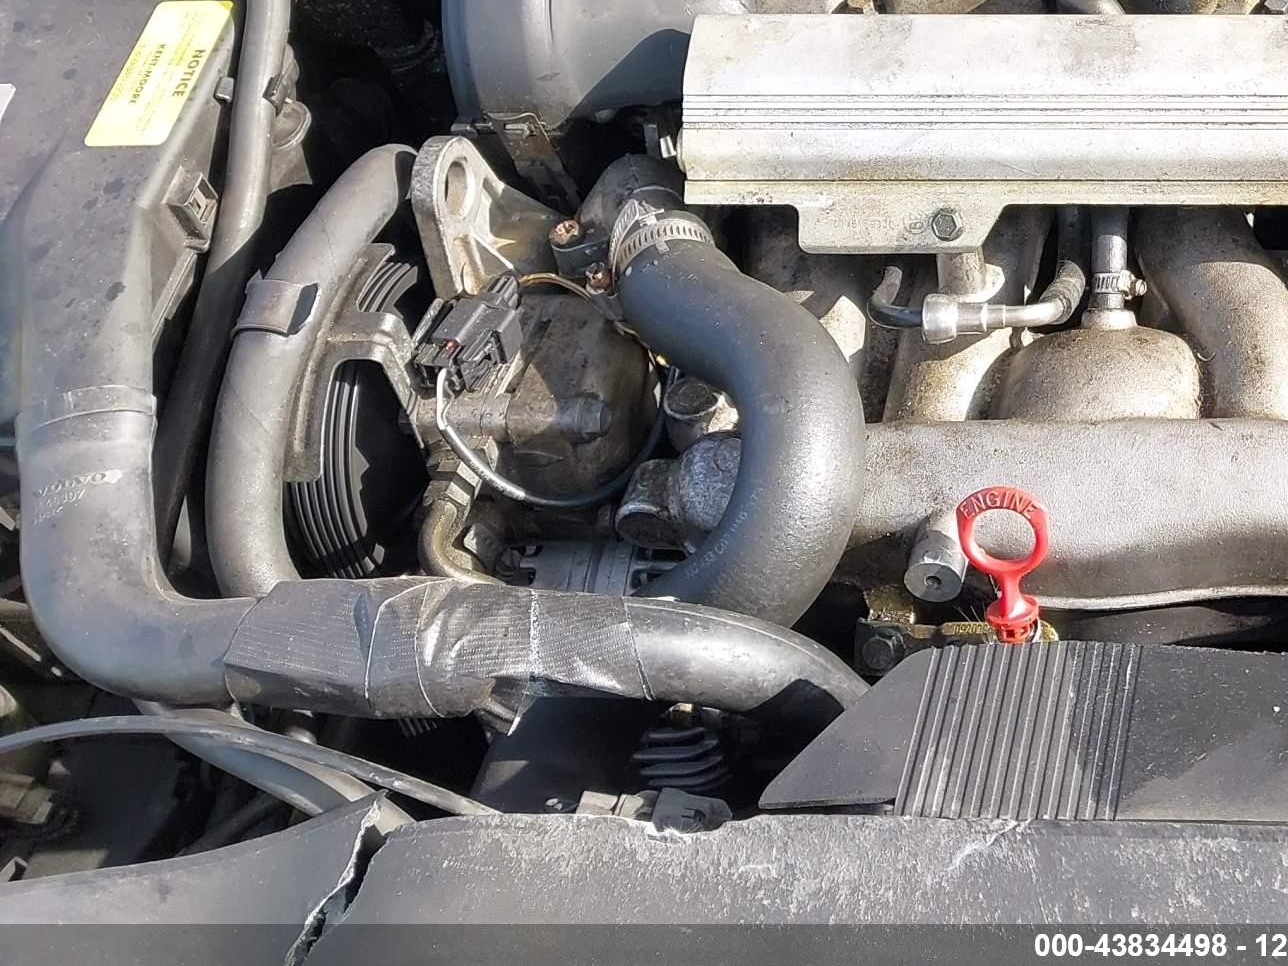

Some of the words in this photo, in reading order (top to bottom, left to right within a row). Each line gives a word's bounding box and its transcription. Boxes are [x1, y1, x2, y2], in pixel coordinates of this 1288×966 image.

[128, 43, 168, 104] KENT-MOORE
[172, 49, 207, 97] NOTICE
[959, 490, 1038, 520] ENGINE
